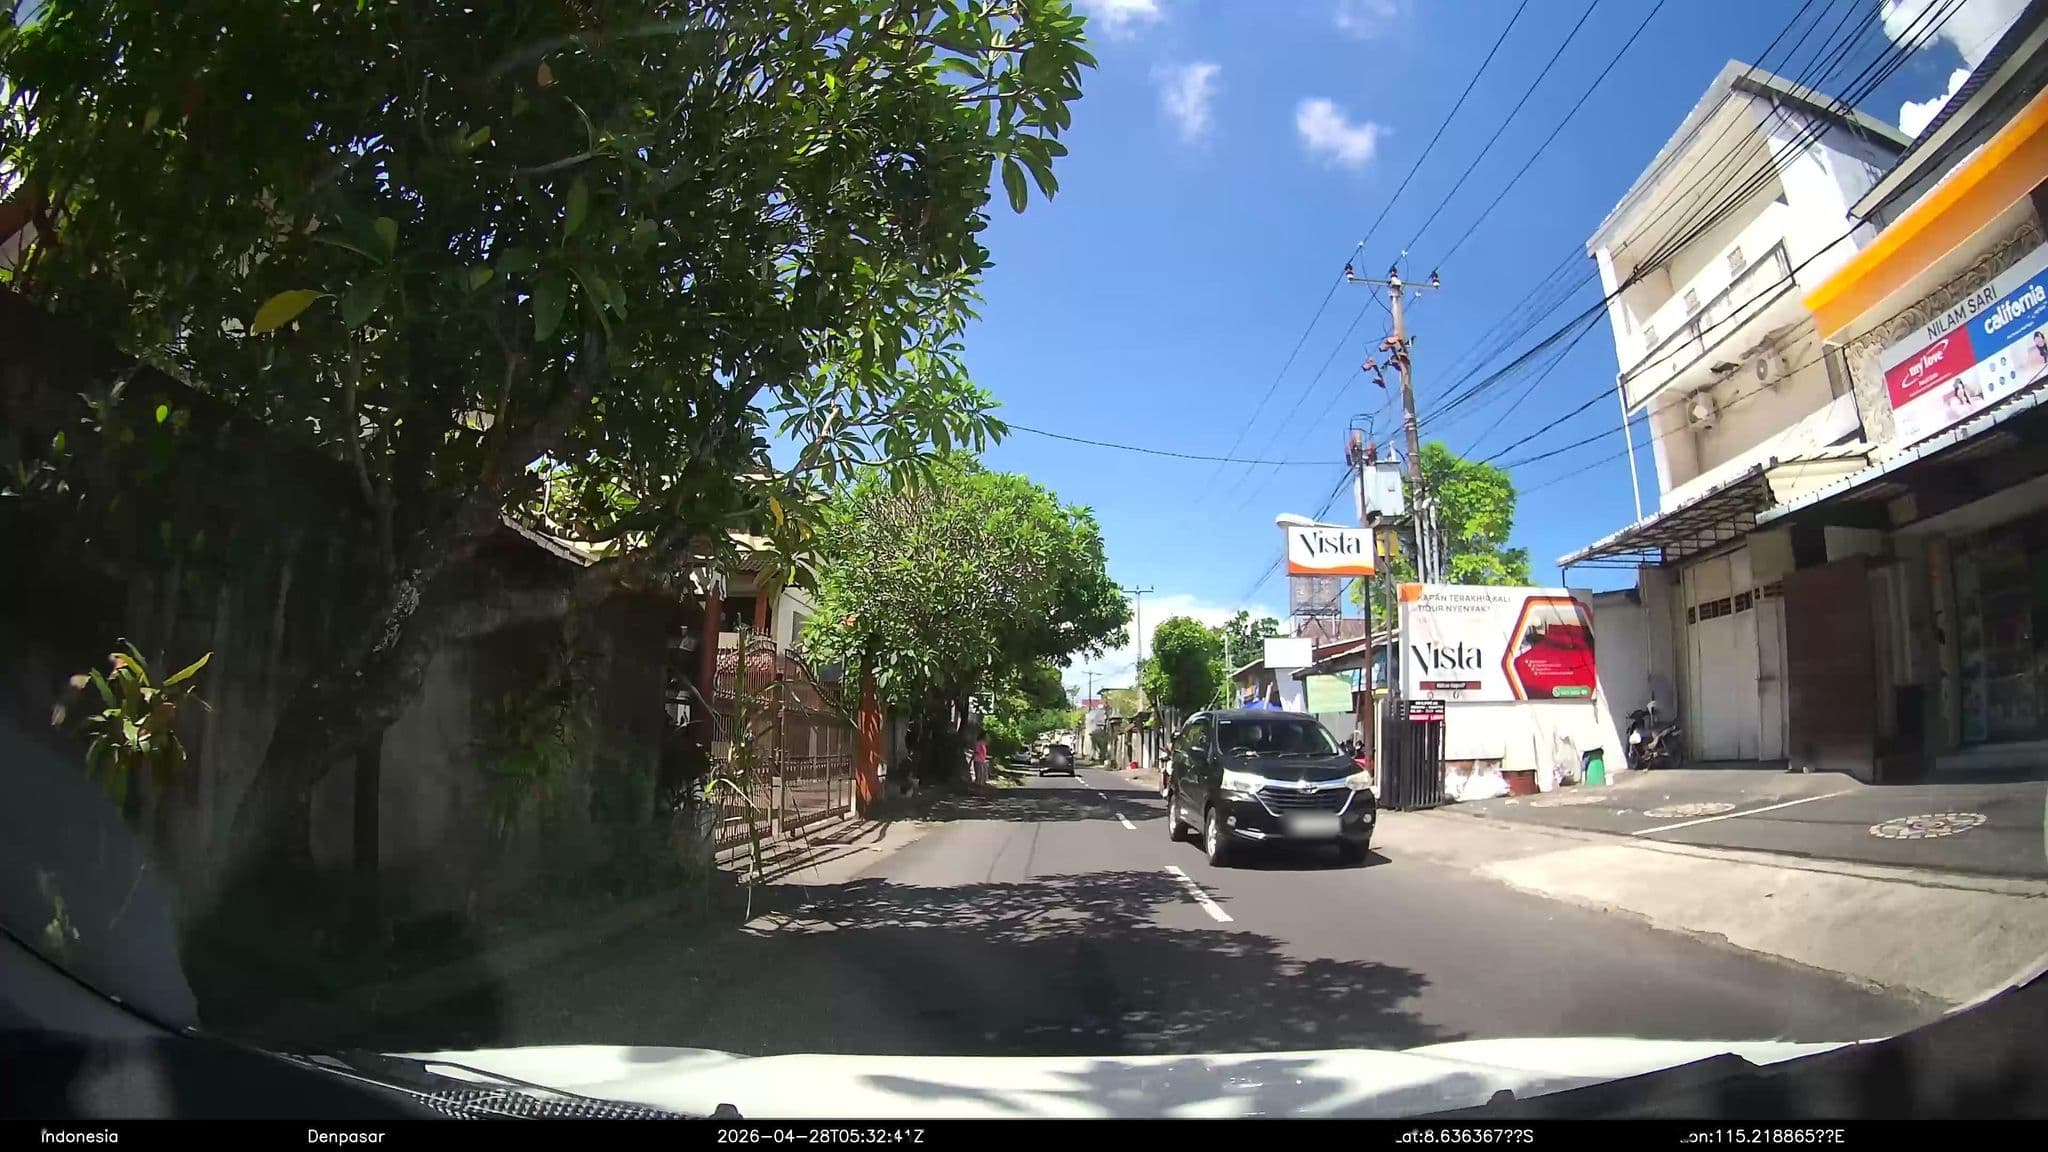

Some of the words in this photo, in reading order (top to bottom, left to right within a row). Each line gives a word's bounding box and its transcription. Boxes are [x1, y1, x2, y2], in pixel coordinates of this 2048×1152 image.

[1927, 306, 1967, 340] NILAM
[1967, 285, 1998, 313] SARI
[1984, 284, 2046, 335] california
[1299, 530, 1361, 559] Vista
[1410, 640, 1482, 677] Vista
